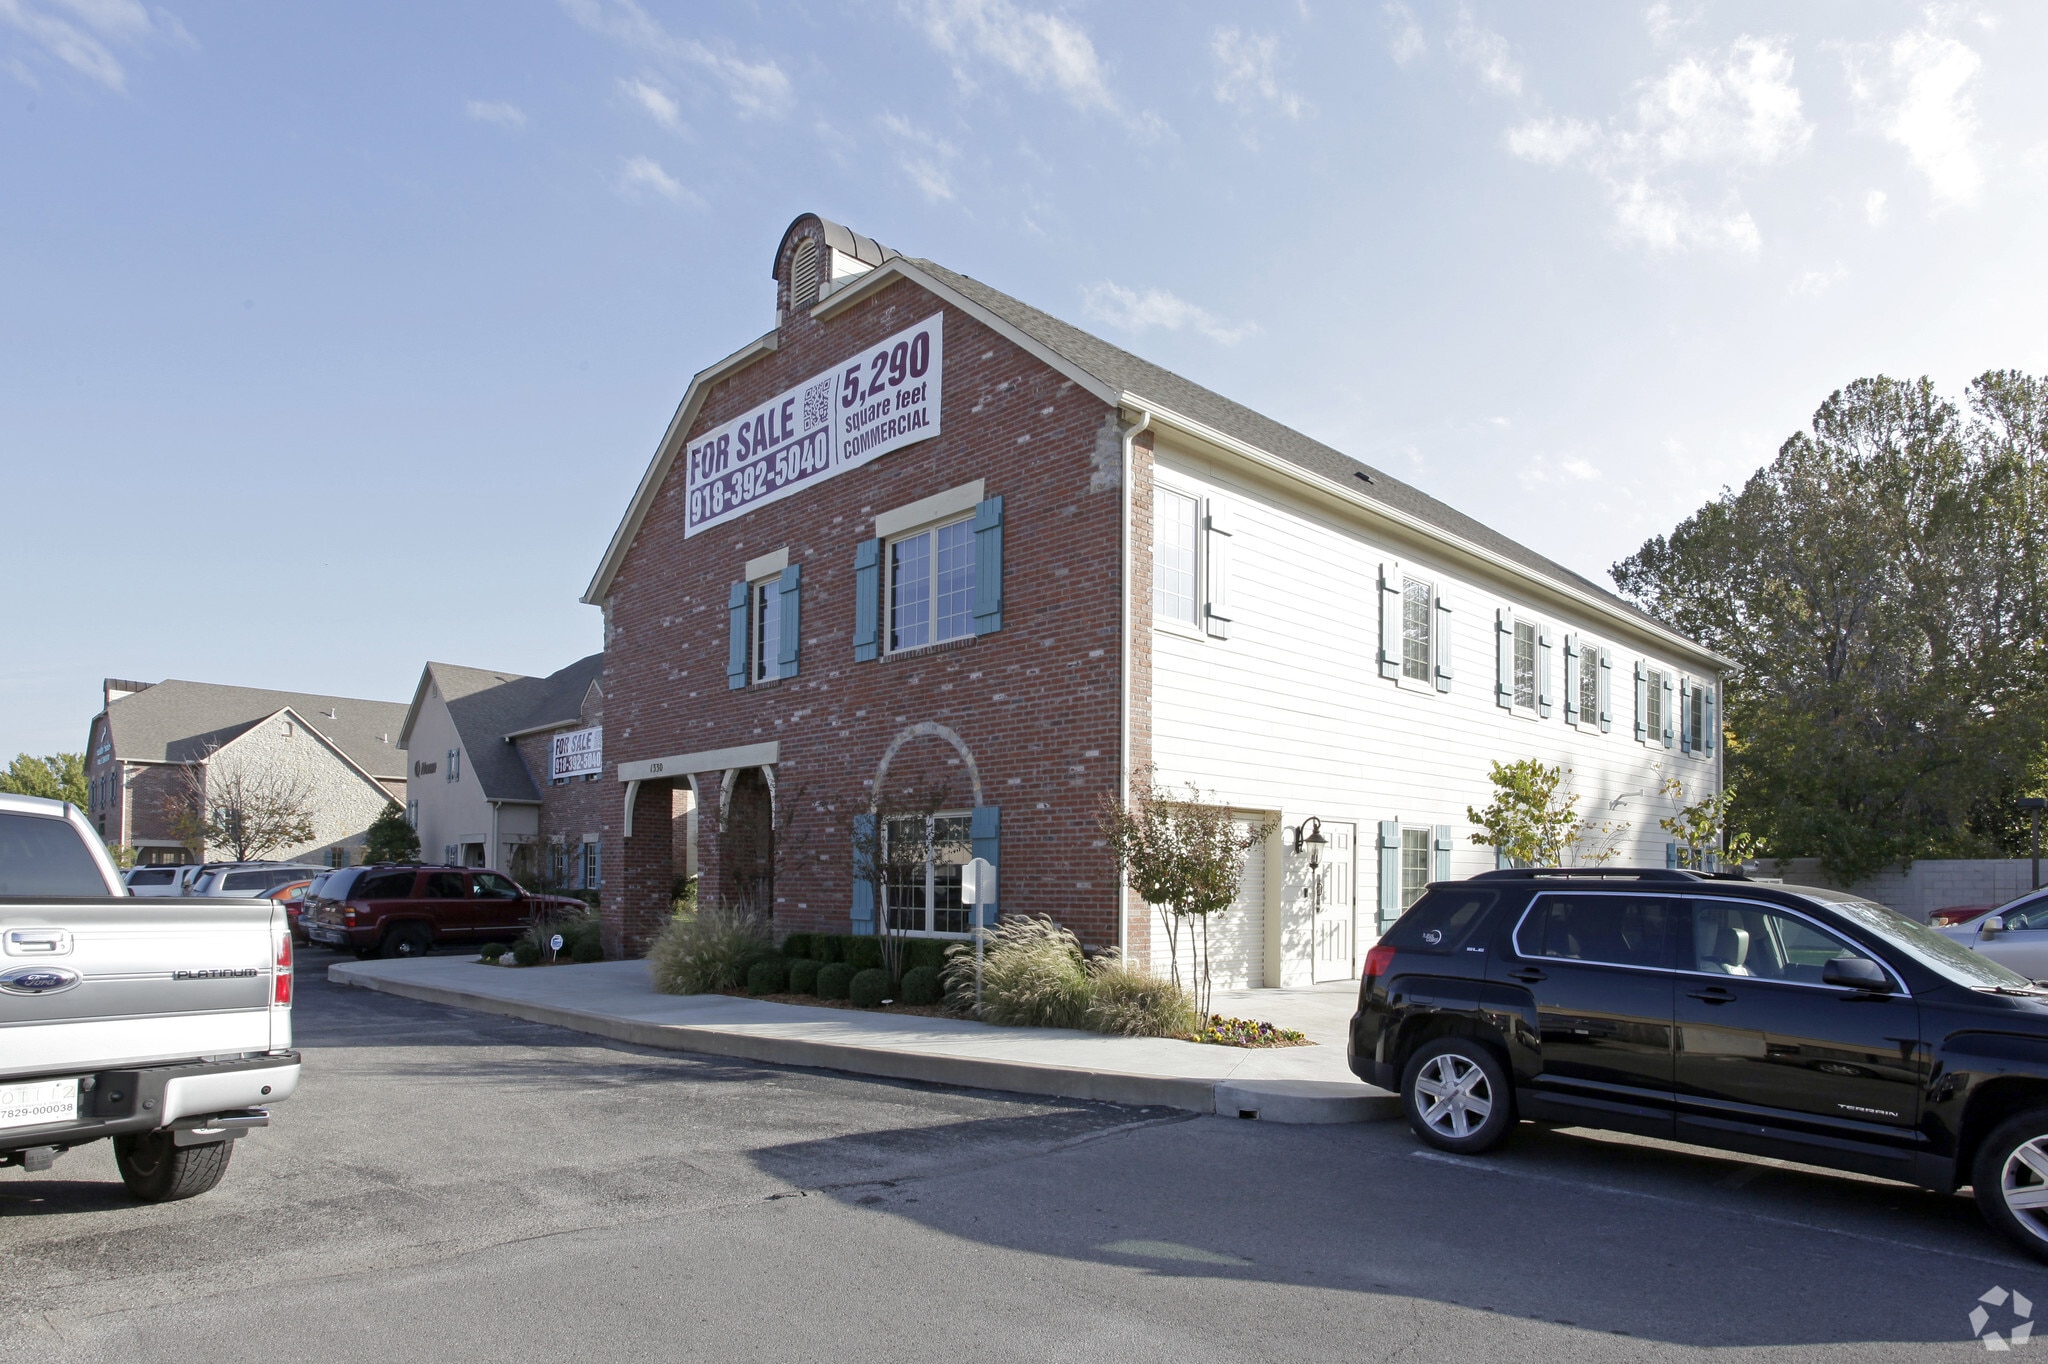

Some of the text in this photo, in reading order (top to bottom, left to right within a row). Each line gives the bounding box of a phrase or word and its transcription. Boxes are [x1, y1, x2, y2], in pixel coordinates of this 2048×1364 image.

[841, 331, 930, 409] 5,290
[845, 381, 927, 434] square feet
[690, 397, 796, 486] FOR SALE
[843, 407, 930, 460] COMMERCIAL
[691, 431, 828, 523] 918-392-5040
[555, 732, 592, 755] FOR SALE
[555, 751, 601, 773] 918-392-5040
[650, 763, 664, 773] 1330
[24, 974, 57, 986] Ford
[177, 968, 258, 979] PLATINUM
[0, 1103, 73, 1119] 7829-000038
[1837, 1103, 1899, 1117] TERRAIN
